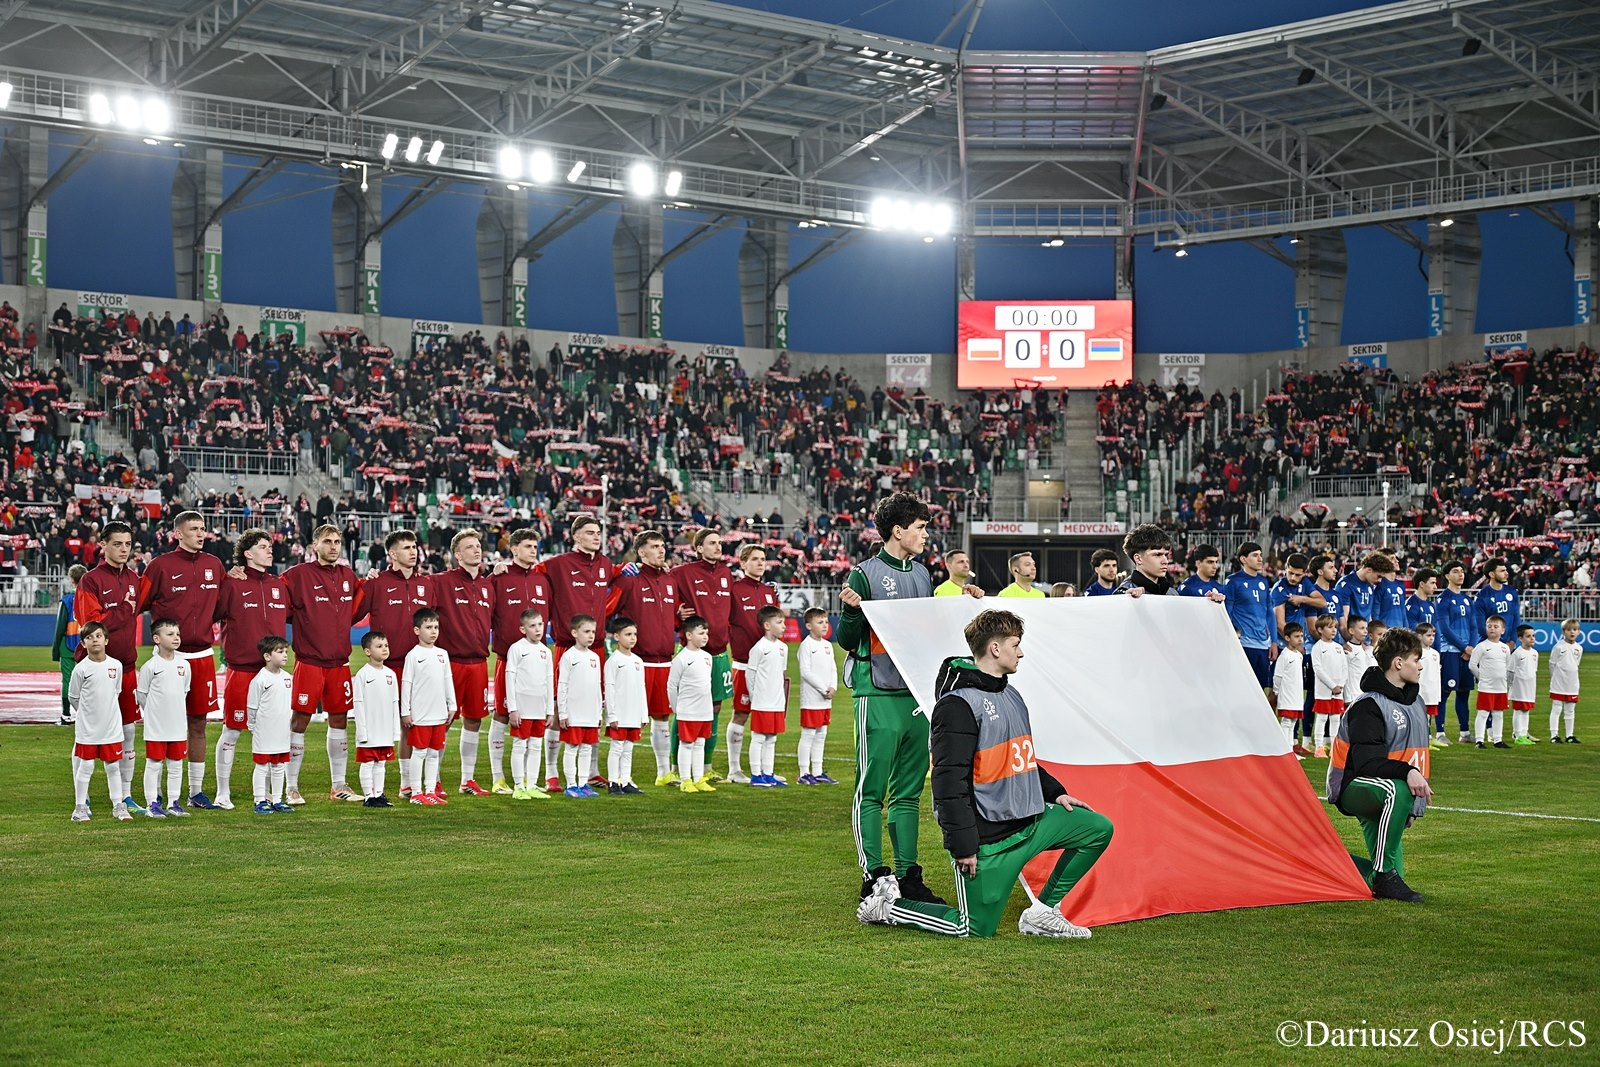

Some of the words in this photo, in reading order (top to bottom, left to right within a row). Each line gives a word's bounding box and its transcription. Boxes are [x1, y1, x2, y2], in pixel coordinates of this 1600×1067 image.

[367, 271, 379, 304] K1
[83, 293, 123, 306] SEKTOR
[515, 287, 526, 318] K2
[1577, 283, 1587, 314] L3
[265, 309, 302, 320] SEKTOR
[651, 299, 661, 330] K3
[1012, 309, 1078, 326] 00:00
[1431, 297, 1440, 327] L2
[416, 321, 450, 333] SEKTOR
[777, 311, 787, 341] K4
[1297, 310, 1306, 339] L1
[572, 334, 604, 345] SEKTOR
[1489, 333, 1522, 344] SEKTOR
[706, 346, 735, 356] SEKTOR
[1015, 338, 1031, 361] 0
[1059, 338, 1075, 361] 0
[1352, 344, 1383, 355] SEKTOR
[891, 355, 927, 364] SEKTOR
[1164, 355, 1200, 364] SEKTOR
[890, 367, 927, 386] K-4
[1163, 367, 1201, 386] K-5
[986, 523, 1023, 533] POMOC
[1063, 524, 1120, 534] MEDYCZNA
[1252, 589, 1260, 603] 4
[1361, 592, 1370, 605] 14
[1391, 593, 1401, 606] 23
[1460, 604, 1466, 616] 8
[1496, 601, 1508, 613] 20
[722, 670, 732, 687] 22
[207, 680, 213, 698] 7
[343, 680, 351, 697] 3
[1011, 739, 1038, 772] 32
